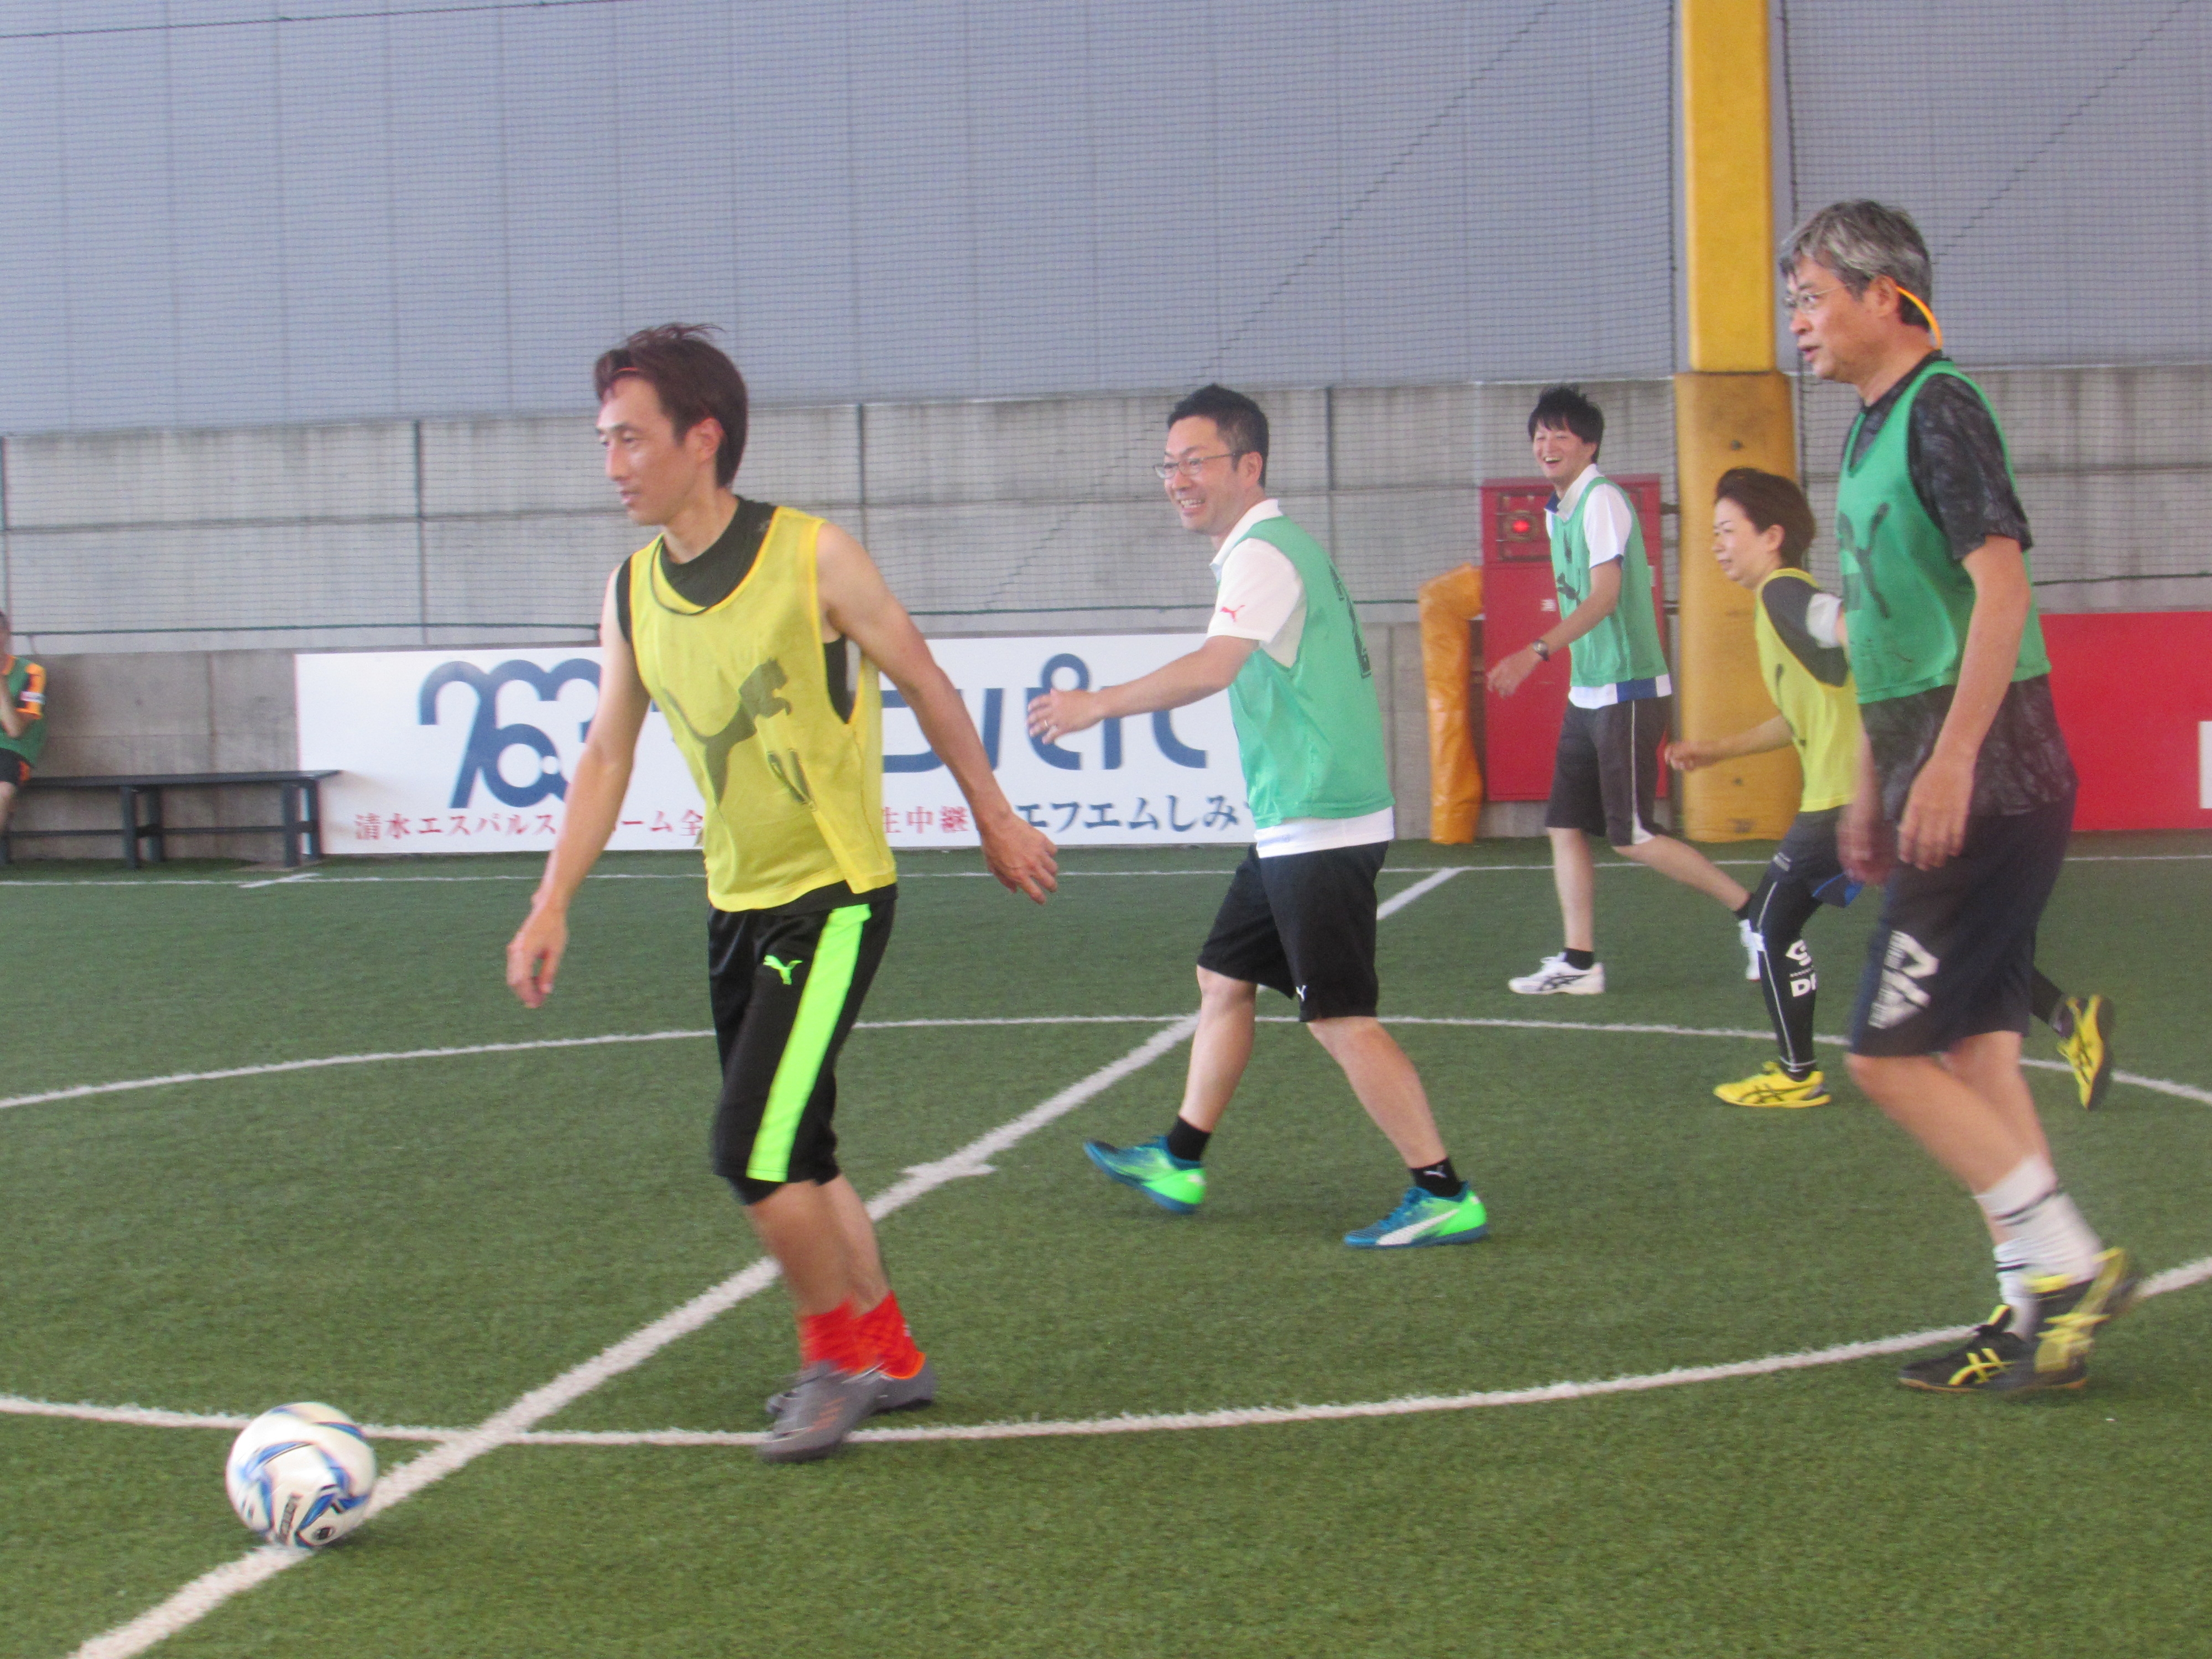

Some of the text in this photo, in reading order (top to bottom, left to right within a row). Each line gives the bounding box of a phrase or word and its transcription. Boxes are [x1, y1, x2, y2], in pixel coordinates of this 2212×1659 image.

[1015, 794, 1250, 833] エフエムしみ
